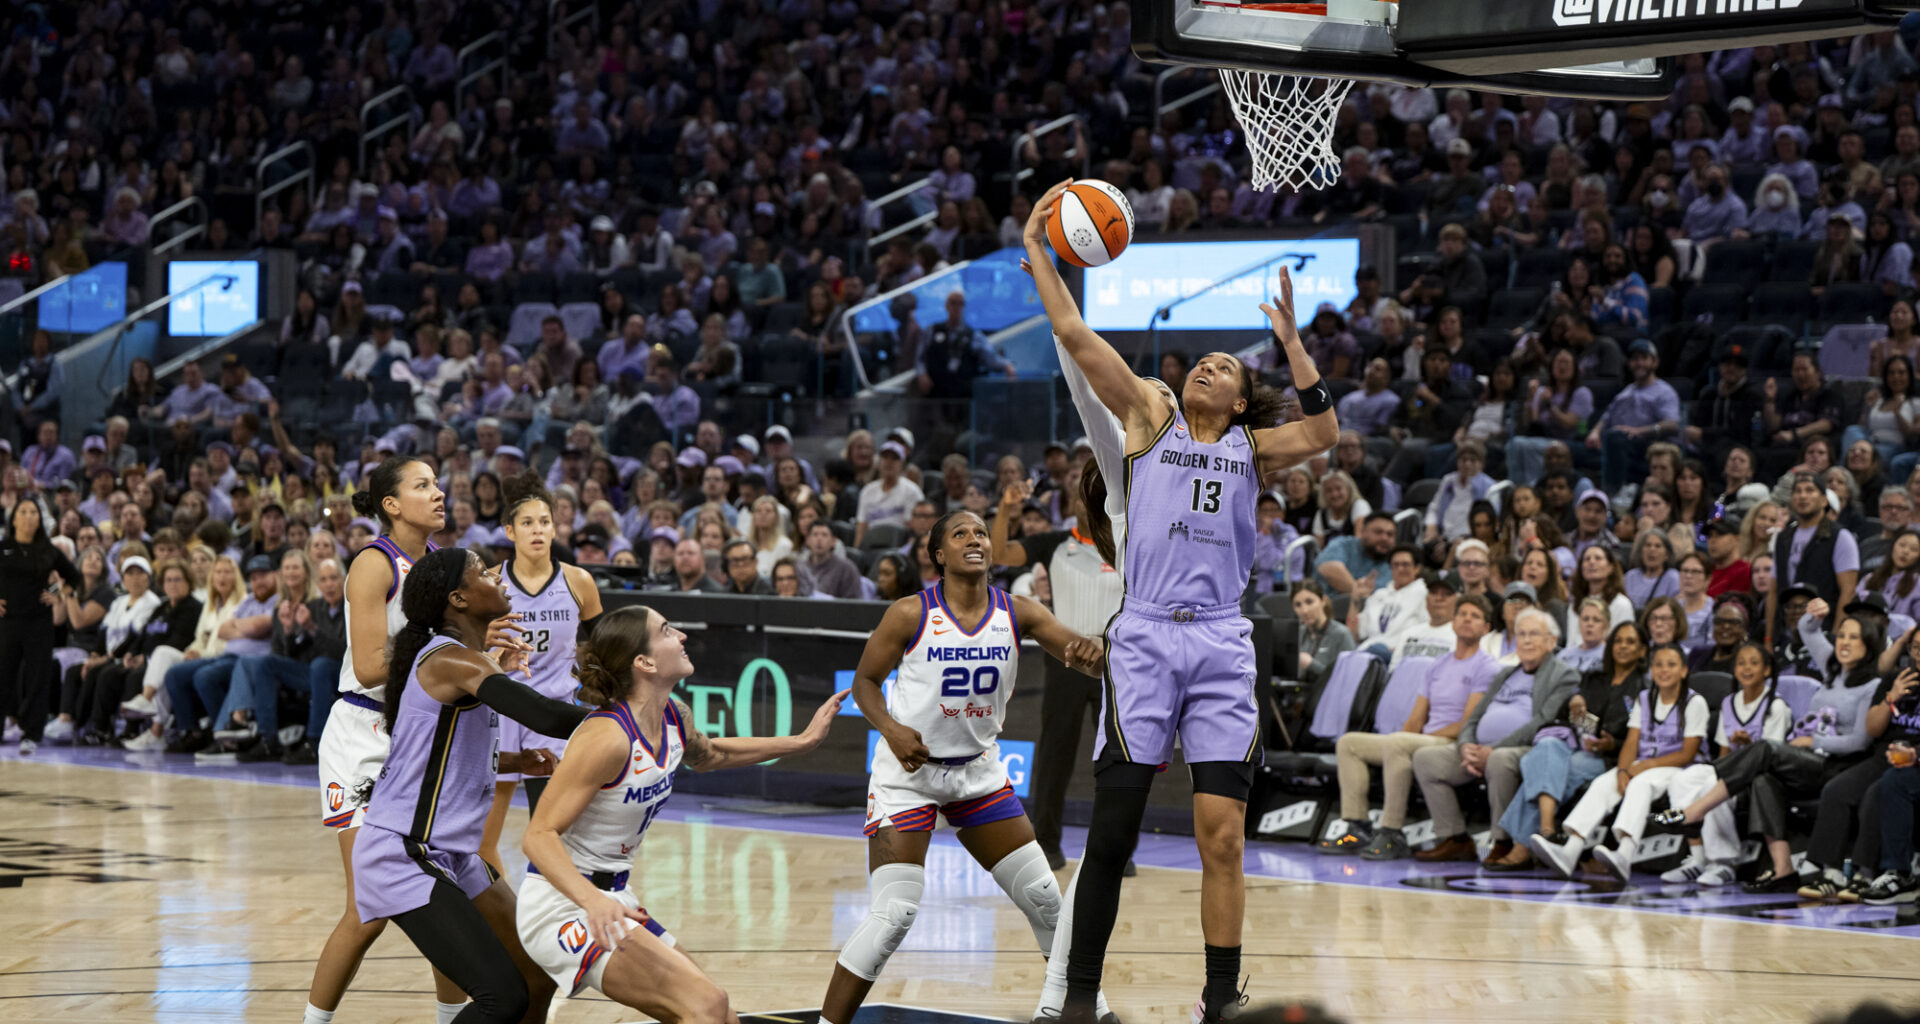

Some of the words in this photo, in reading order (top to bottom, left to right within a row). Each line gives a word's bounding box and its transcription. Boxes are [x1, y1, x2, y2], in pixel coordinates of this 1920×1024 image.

[1160, 450, 1209, 470] GOLDEN
[1191, 478, 1223, 514] 13
[1193, 537, 1232, 548] PERMANENTE
[1194, 529, 1215, 537] KAISER
[540, 609, 570, 622] STATE
[521, 629, 550, 653] 22
[927, 646, 1011, 662] MERCURY
[941, 666, 1000, 697] 20
[670, 658, 792, 771] FO
[622, 770, 676, 804] MERCU
